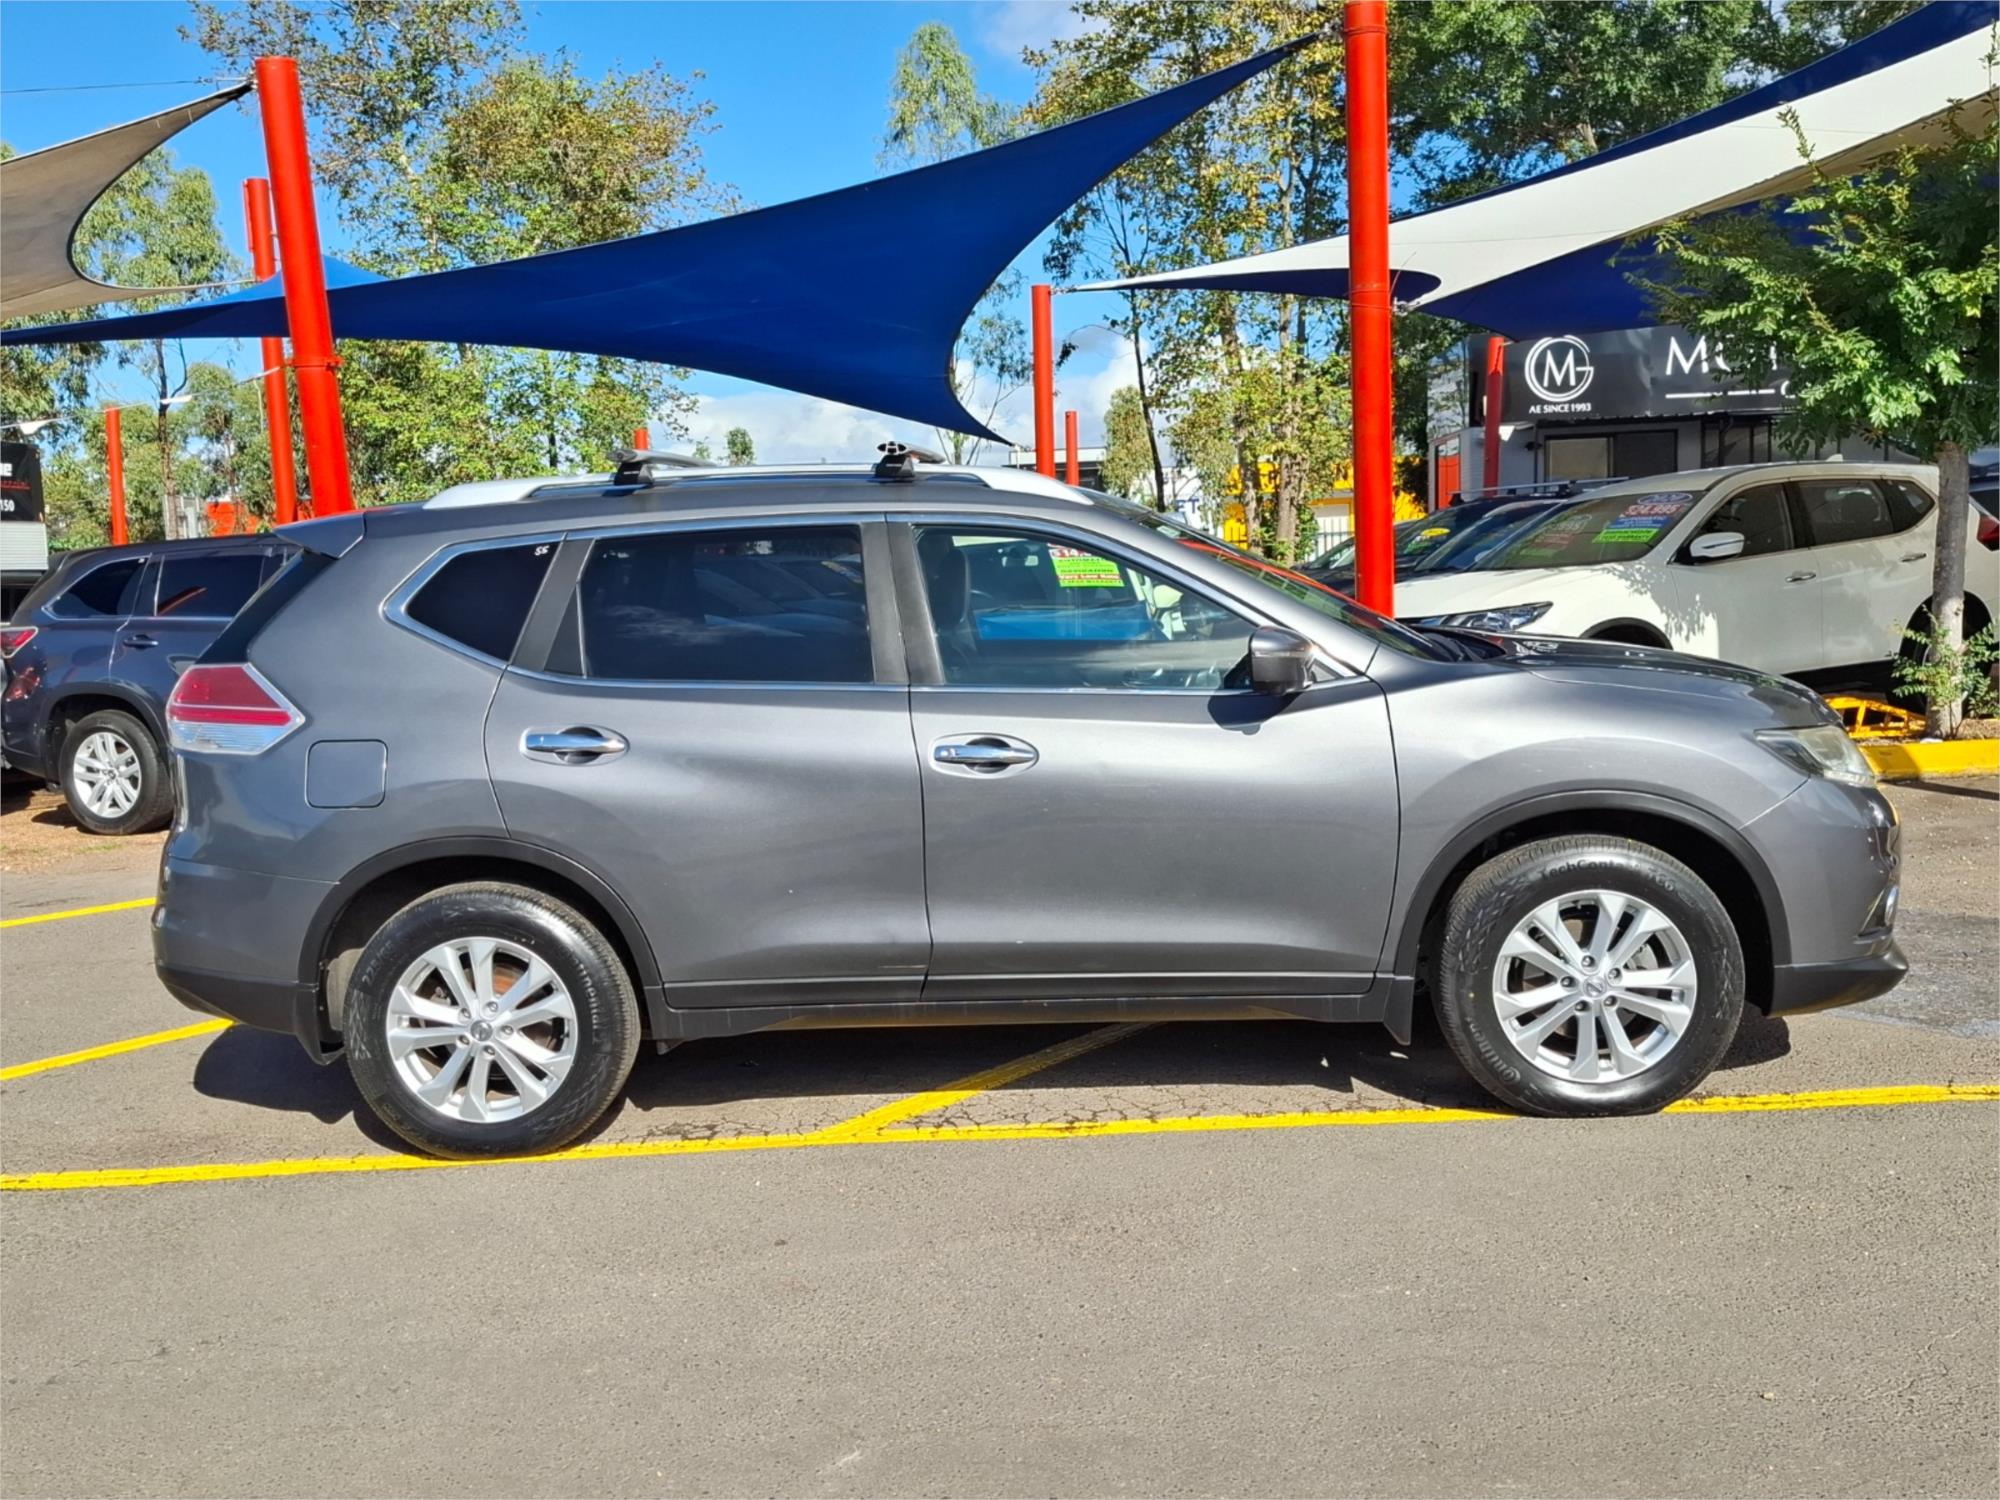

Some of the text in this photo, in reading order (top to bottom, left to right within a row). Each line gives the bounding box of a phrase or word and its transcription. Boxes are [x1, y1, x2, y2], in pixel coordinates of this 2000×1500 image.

[1543, 403, 1570, 413] SINCE
[1571, 402, 1592, 412] 1993
[1541, 859, 1645, 882] TechConta
[1463, 1014, 1522, 1083] Continent
